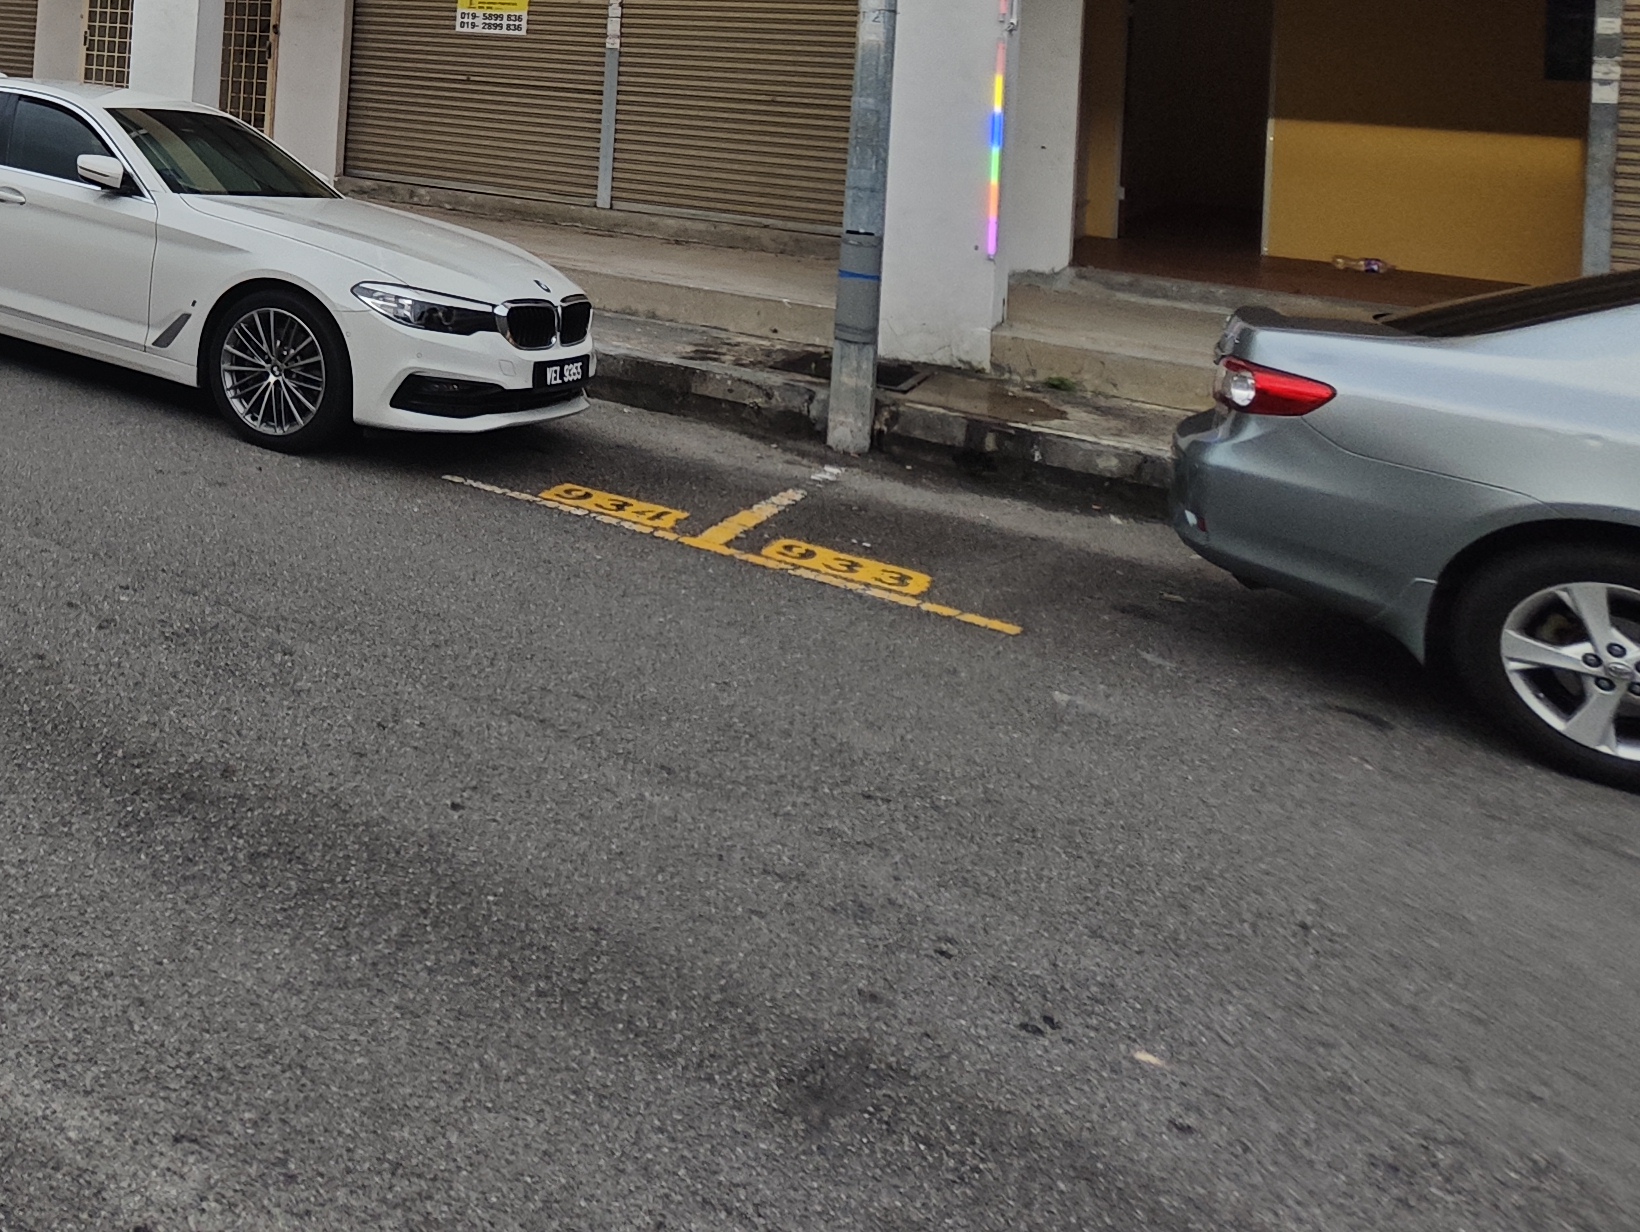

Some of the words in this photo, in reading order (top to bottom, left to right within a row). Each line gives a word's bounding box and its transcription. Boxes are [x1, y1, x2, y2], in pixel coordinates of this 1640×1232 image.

[547, 366, 562, 386] VEL
[553, 487, 673, 522] 934
[777, 543, 915, 588] 933
